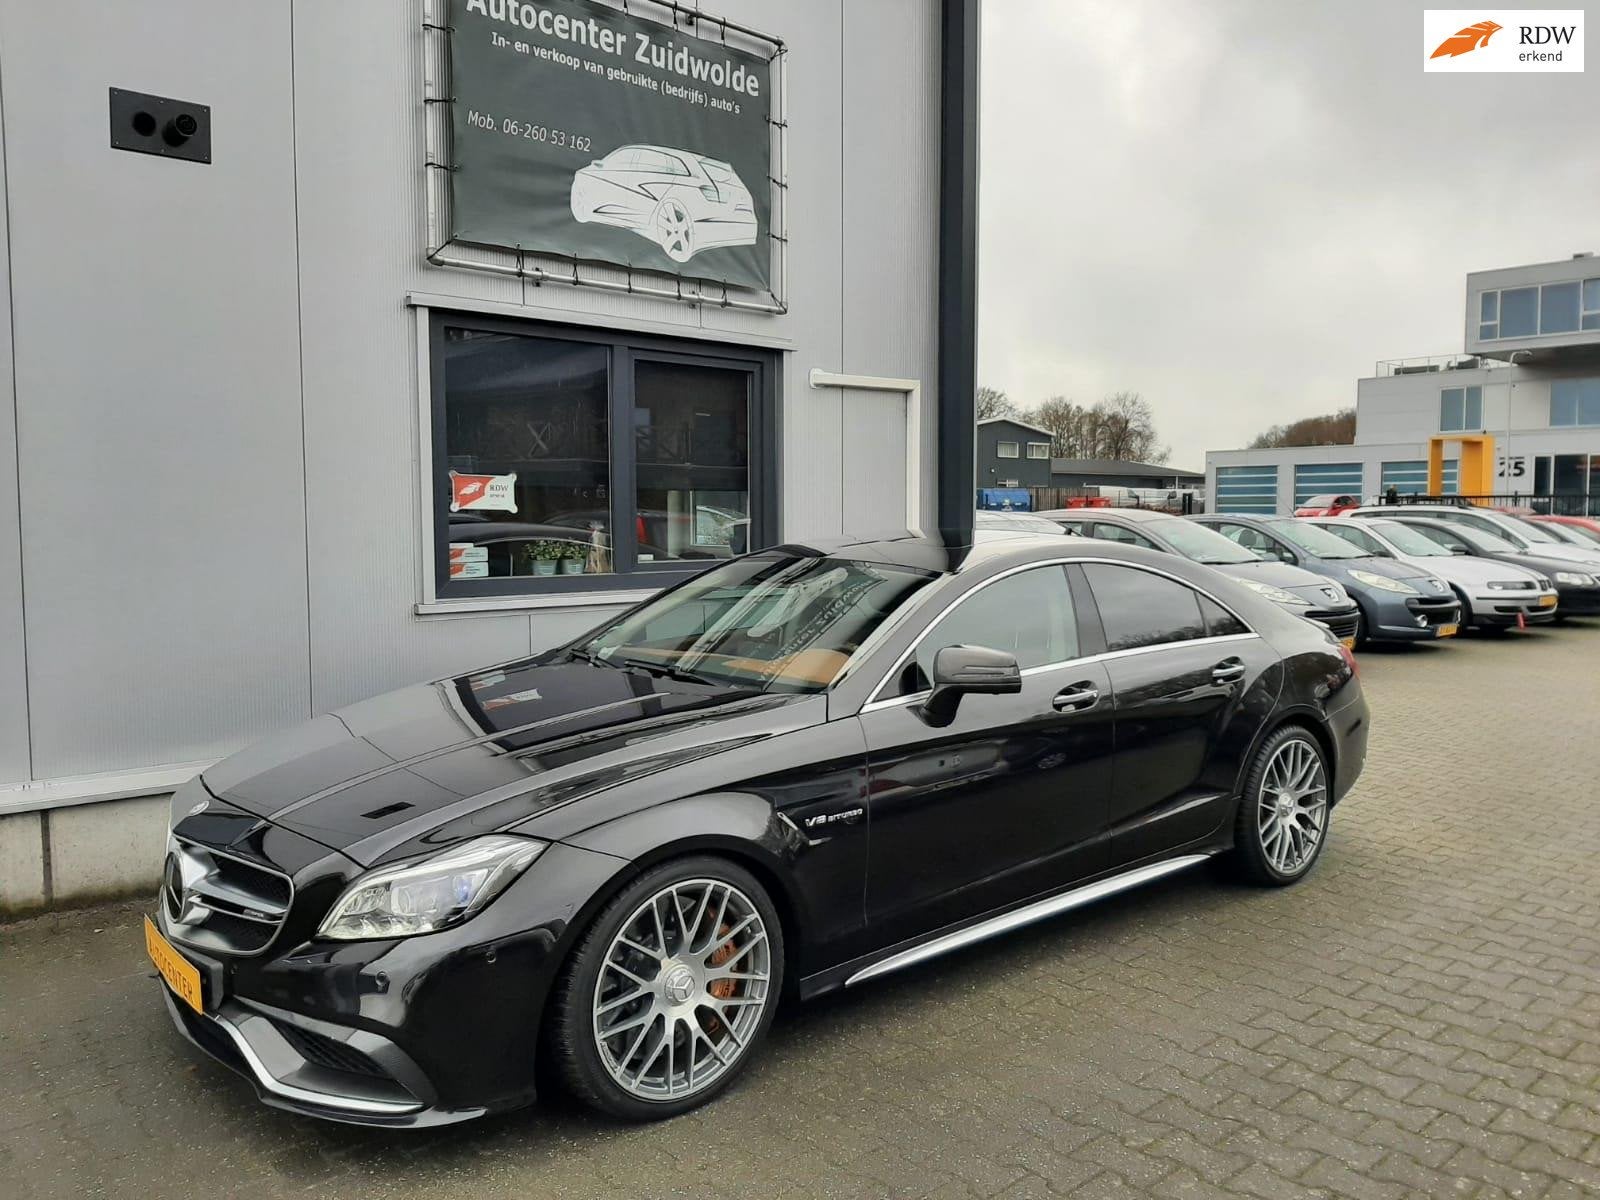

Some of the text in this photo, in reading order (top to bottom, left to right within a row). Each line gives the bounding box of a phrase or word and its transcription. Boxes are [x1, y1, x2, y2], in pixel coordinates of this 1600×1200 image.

[467, 0, 759, 96] Autocenter Zuidwolde
[491, 31, 741, 115] In- en verkoop van gebruikte (bedrijfs) auto's
[467, 110, 592, 152] Mob. 06-260 53 162
[1498, 461, 1525, 477] 25
[805, 814, 827, 827] V8
